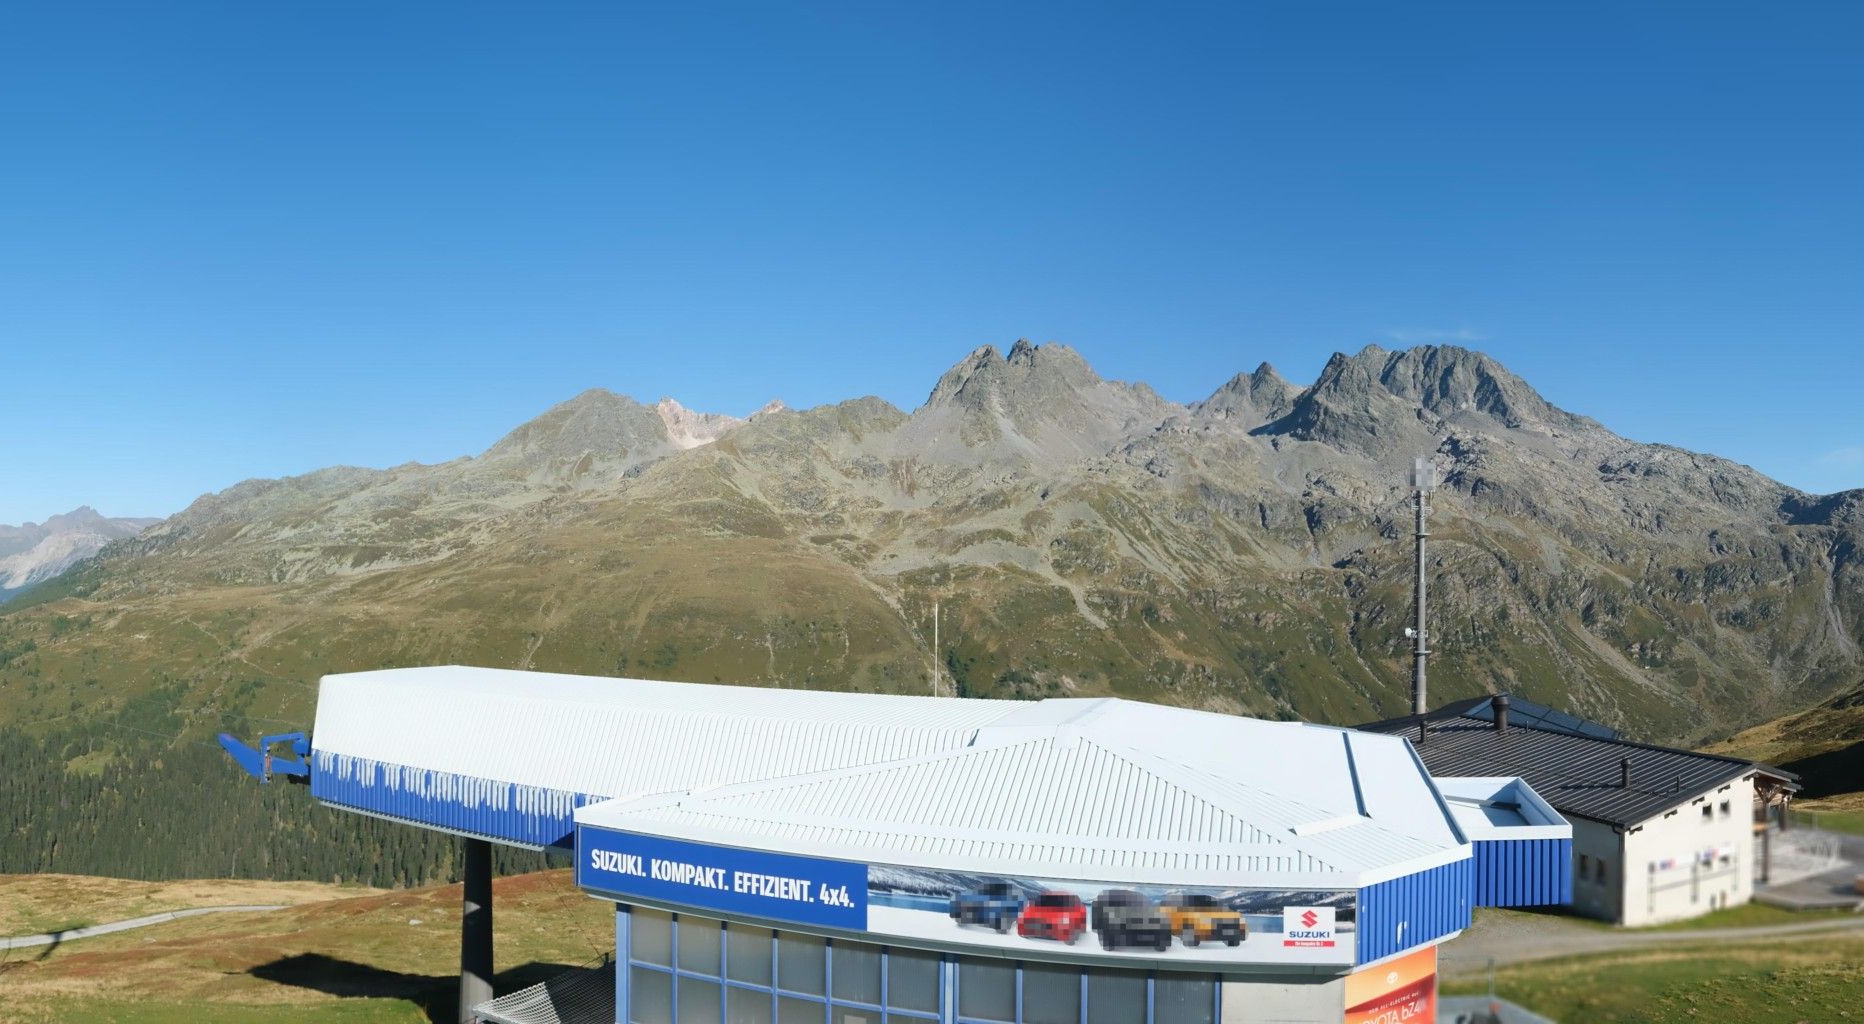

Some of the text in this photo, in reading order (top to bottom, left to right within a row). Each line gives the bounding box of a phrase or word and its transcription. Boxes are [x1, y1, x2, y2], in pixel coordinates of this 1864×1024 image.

[591, 849, 855, 908] SUZUKI. KOMPAKT. EFFIZIENT. 4x4.
[1401, 999, 1427, 1020] bZ4
